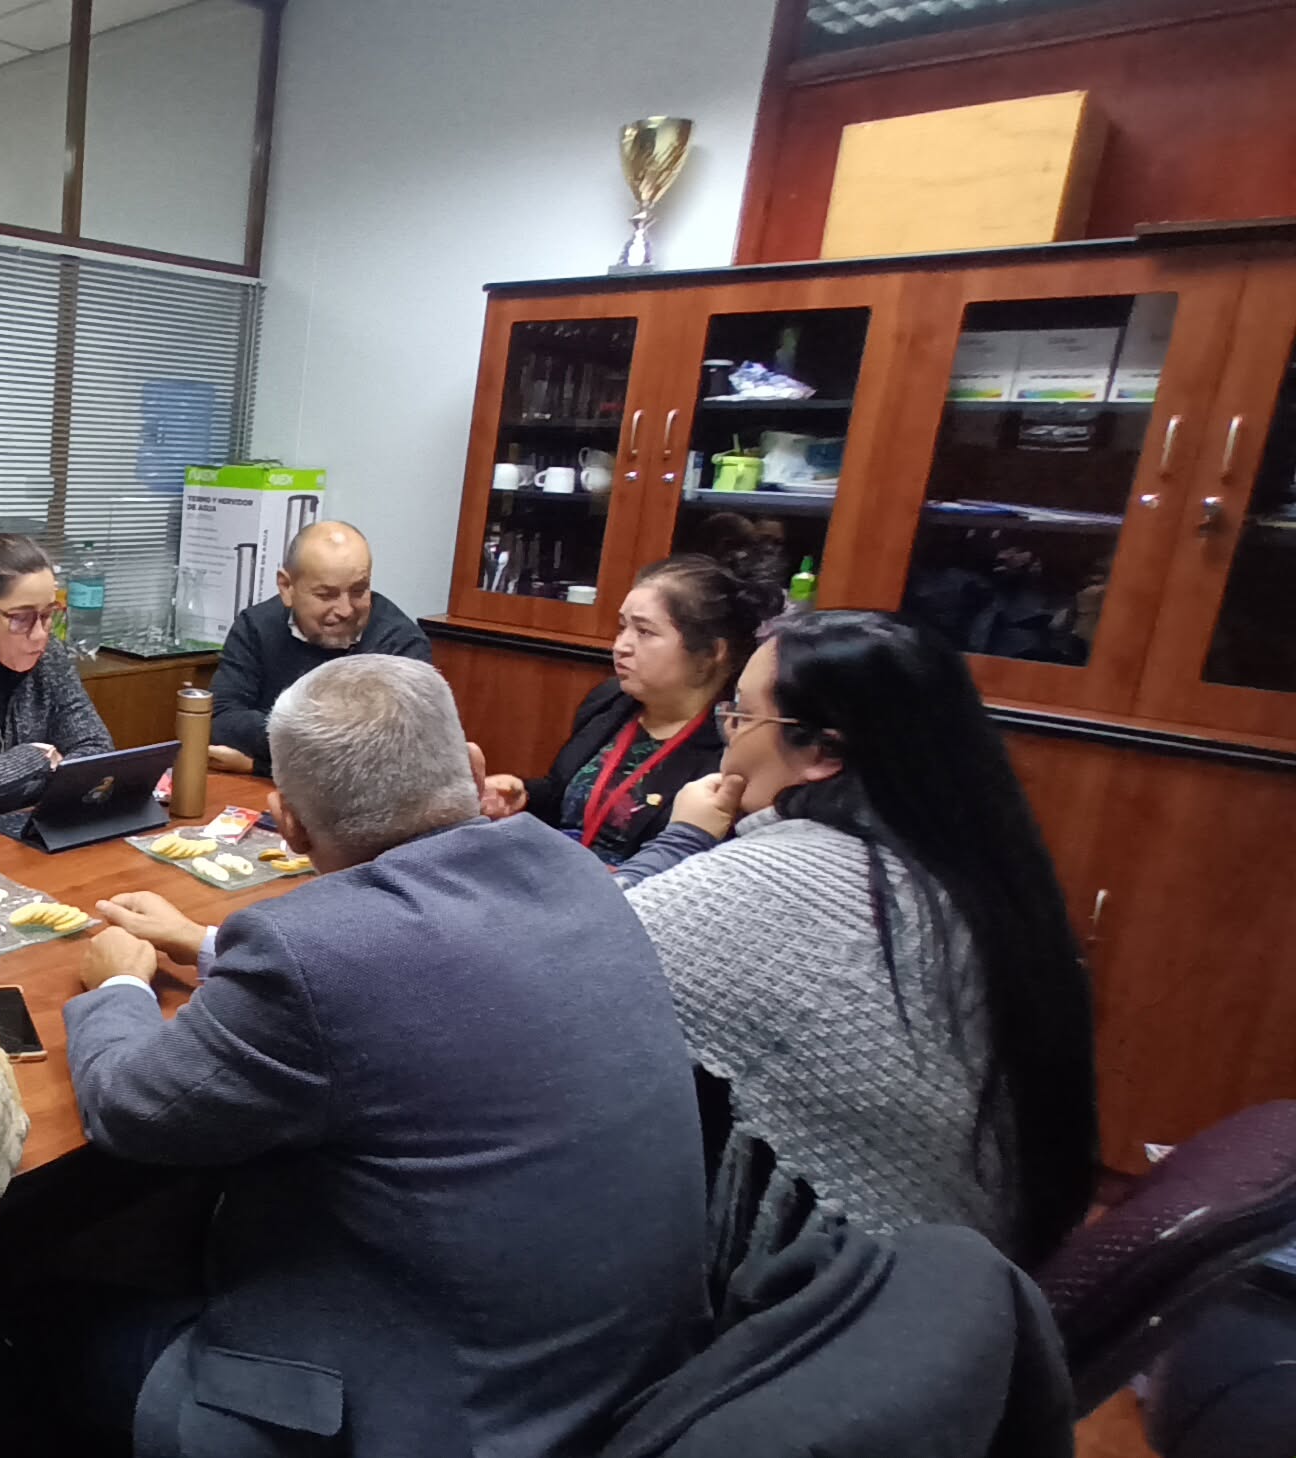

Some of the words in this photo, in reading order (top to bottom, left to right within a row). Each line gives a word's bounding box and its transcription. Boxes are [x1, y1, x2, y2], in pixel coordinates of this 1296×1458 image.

[187, 495, 211, 503] TERMO
[218, 497, 254, 506] HERVIDOR
[186, 503, 196, 511] DE
[198, 504, 217, 512] AGUA
